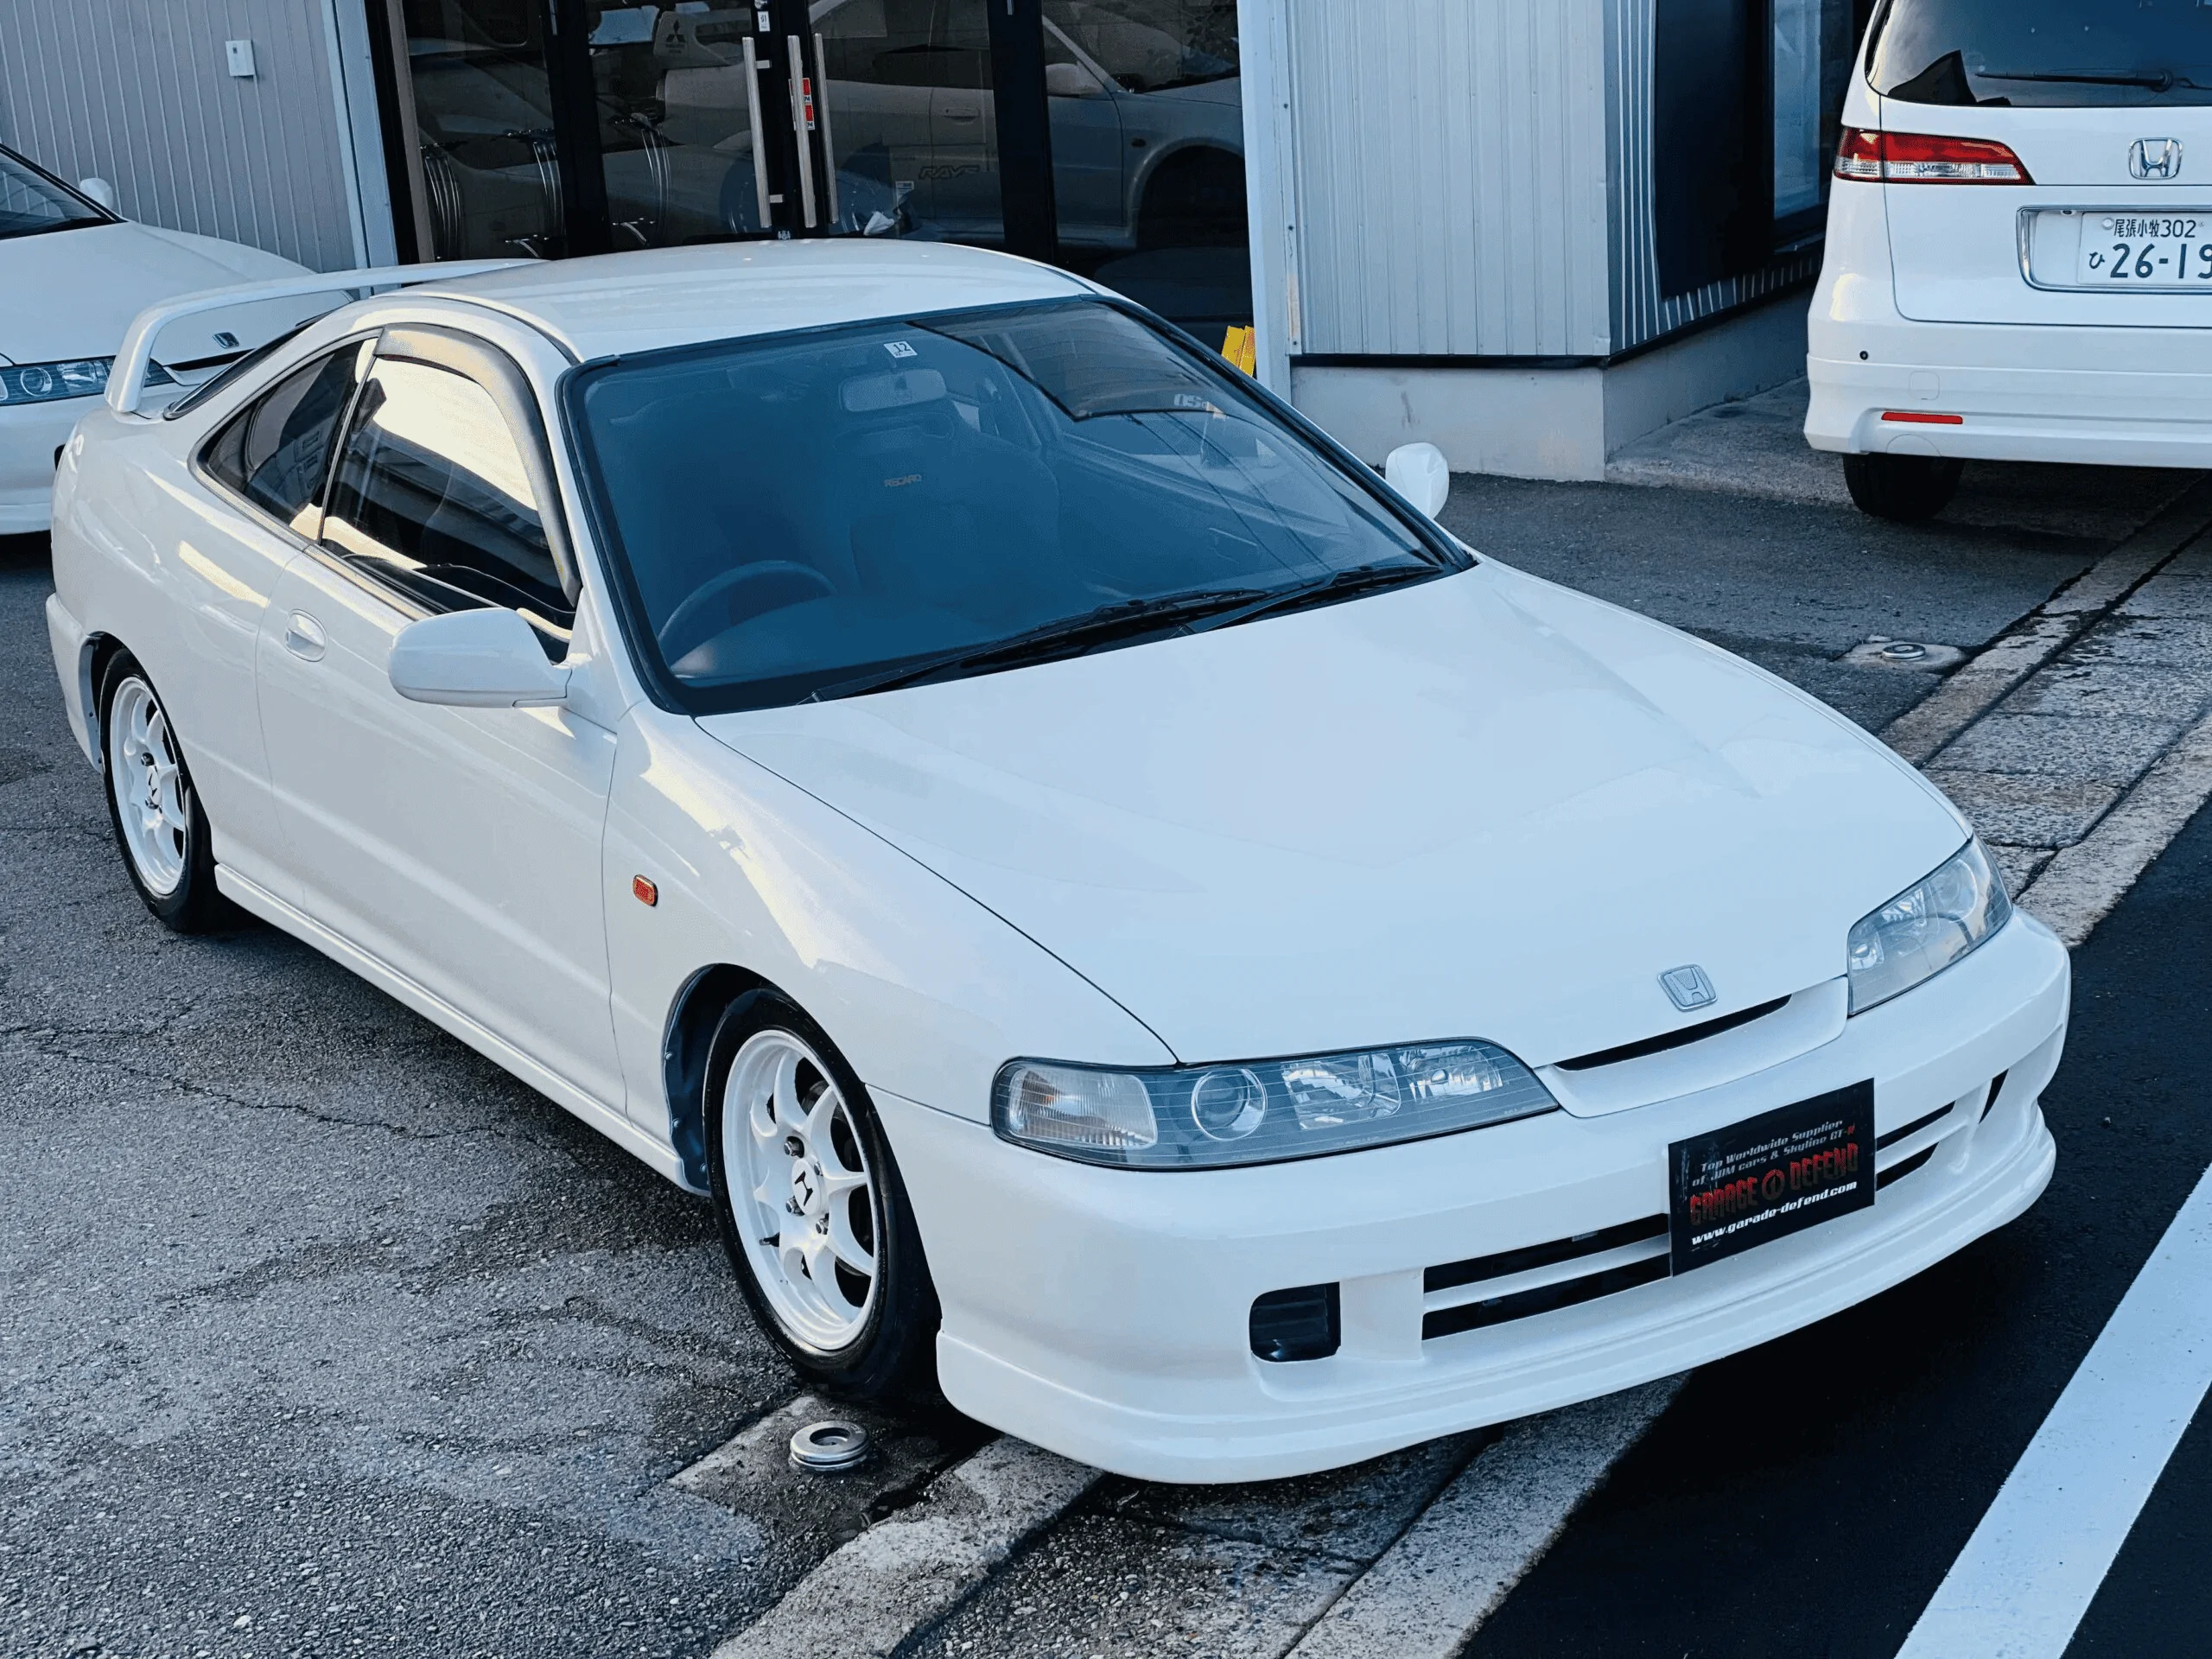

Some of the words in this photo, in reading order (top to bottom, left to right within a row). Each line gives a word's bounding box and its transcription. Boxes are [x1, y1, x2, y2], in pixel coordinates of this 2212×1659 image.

[2088, 251, 2106, 270] ひ
[893, 342, 912, 353] 12
[1692, 1176, 1707, 1187] of
[1710, 1165, 1736, 1182] JDM
[1738, 1156, 1767, 1171] cars
[1770, 1150, 1779, 1159] &
[1783, 1135, 1827, 1156] Skyline
[1700, 1160, 1724, 1173] Top
[1726, 1137, 1789, 1164] Worldwide
[1791, 1120, 1843, 1141] Supplier
[1689, 1176, 1758, 1227] GARAGE
[1789, 1142, 1859, 1192] DEFEND
